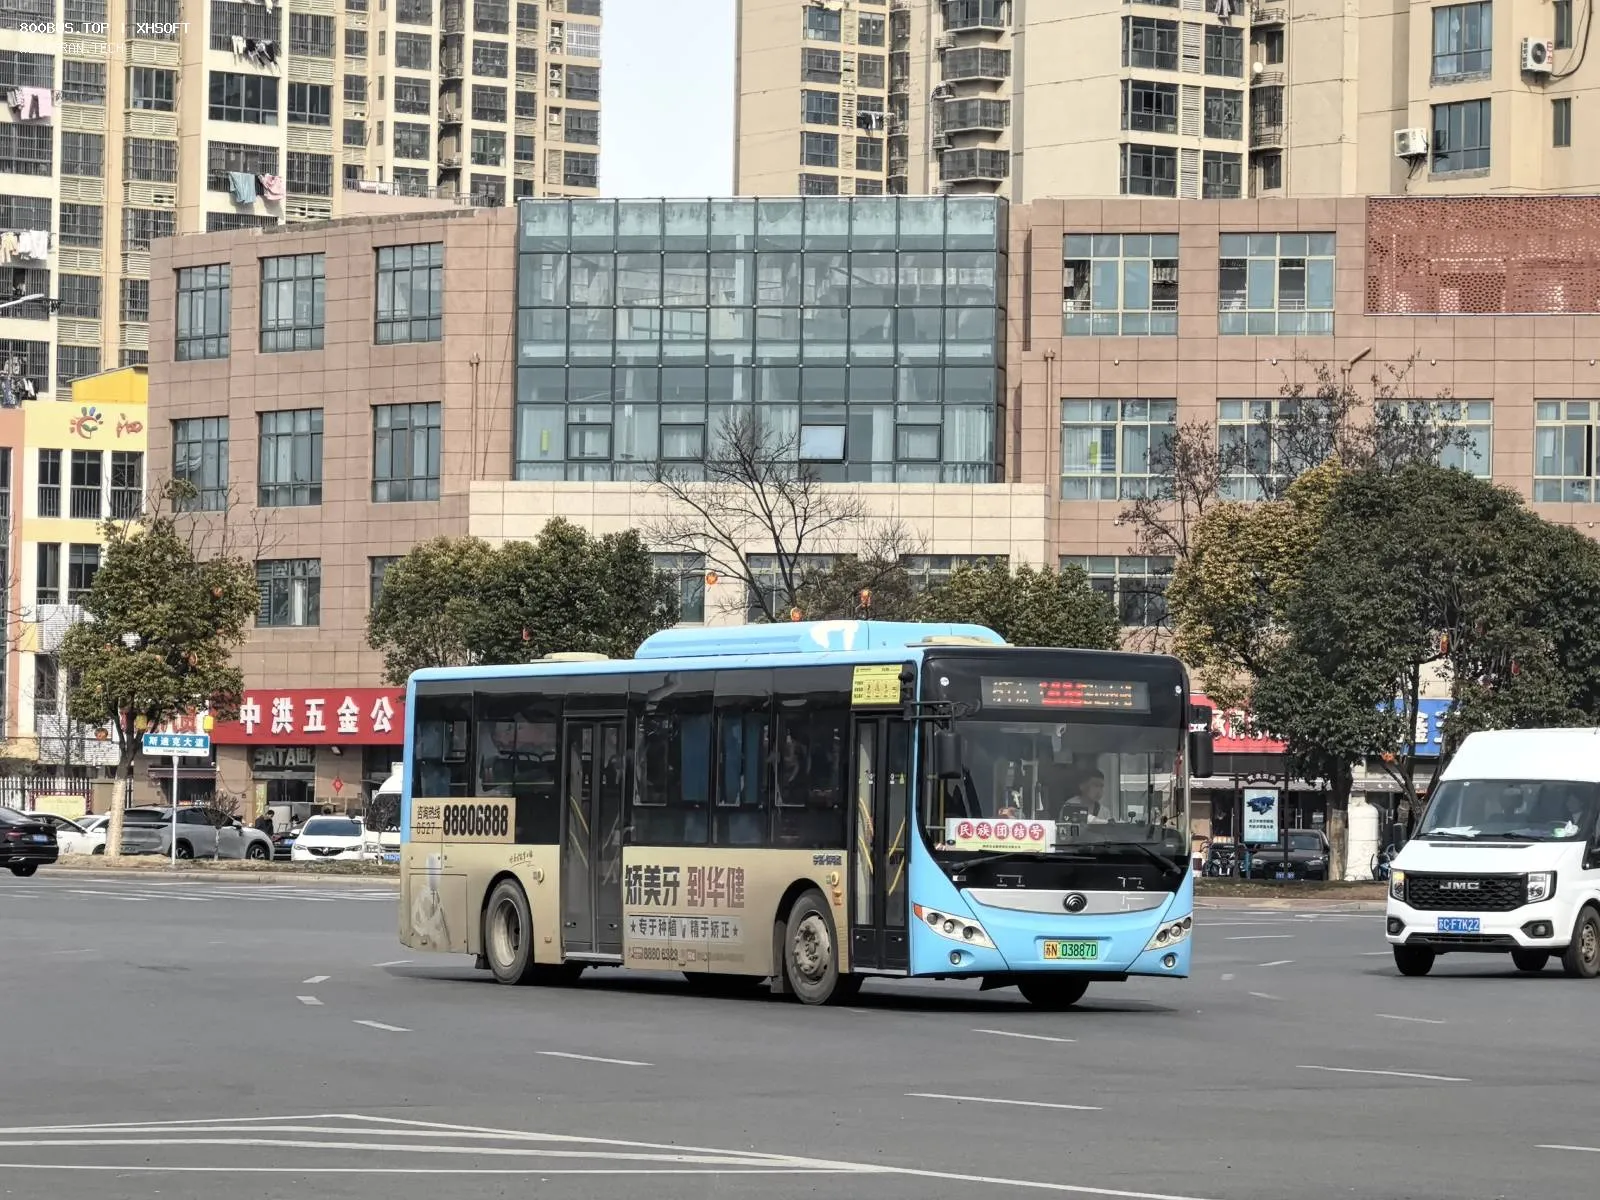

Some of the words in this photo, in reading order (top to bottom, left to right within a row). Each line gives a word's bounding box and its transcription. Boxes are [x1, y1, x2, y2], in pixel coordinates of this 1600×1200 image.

[239, 696, 394, 735] 中洪五金公
[443, 804, 509, 836] 88806888
[958, 822, 1044, 841] 民族团结号
[625, 864, 680, 906] 矫美牙
[687, 866, 745, 908] 到华健
[1439, 881, 1480, 890] JMC
[1061, 943, 1097, 957] 03887D
